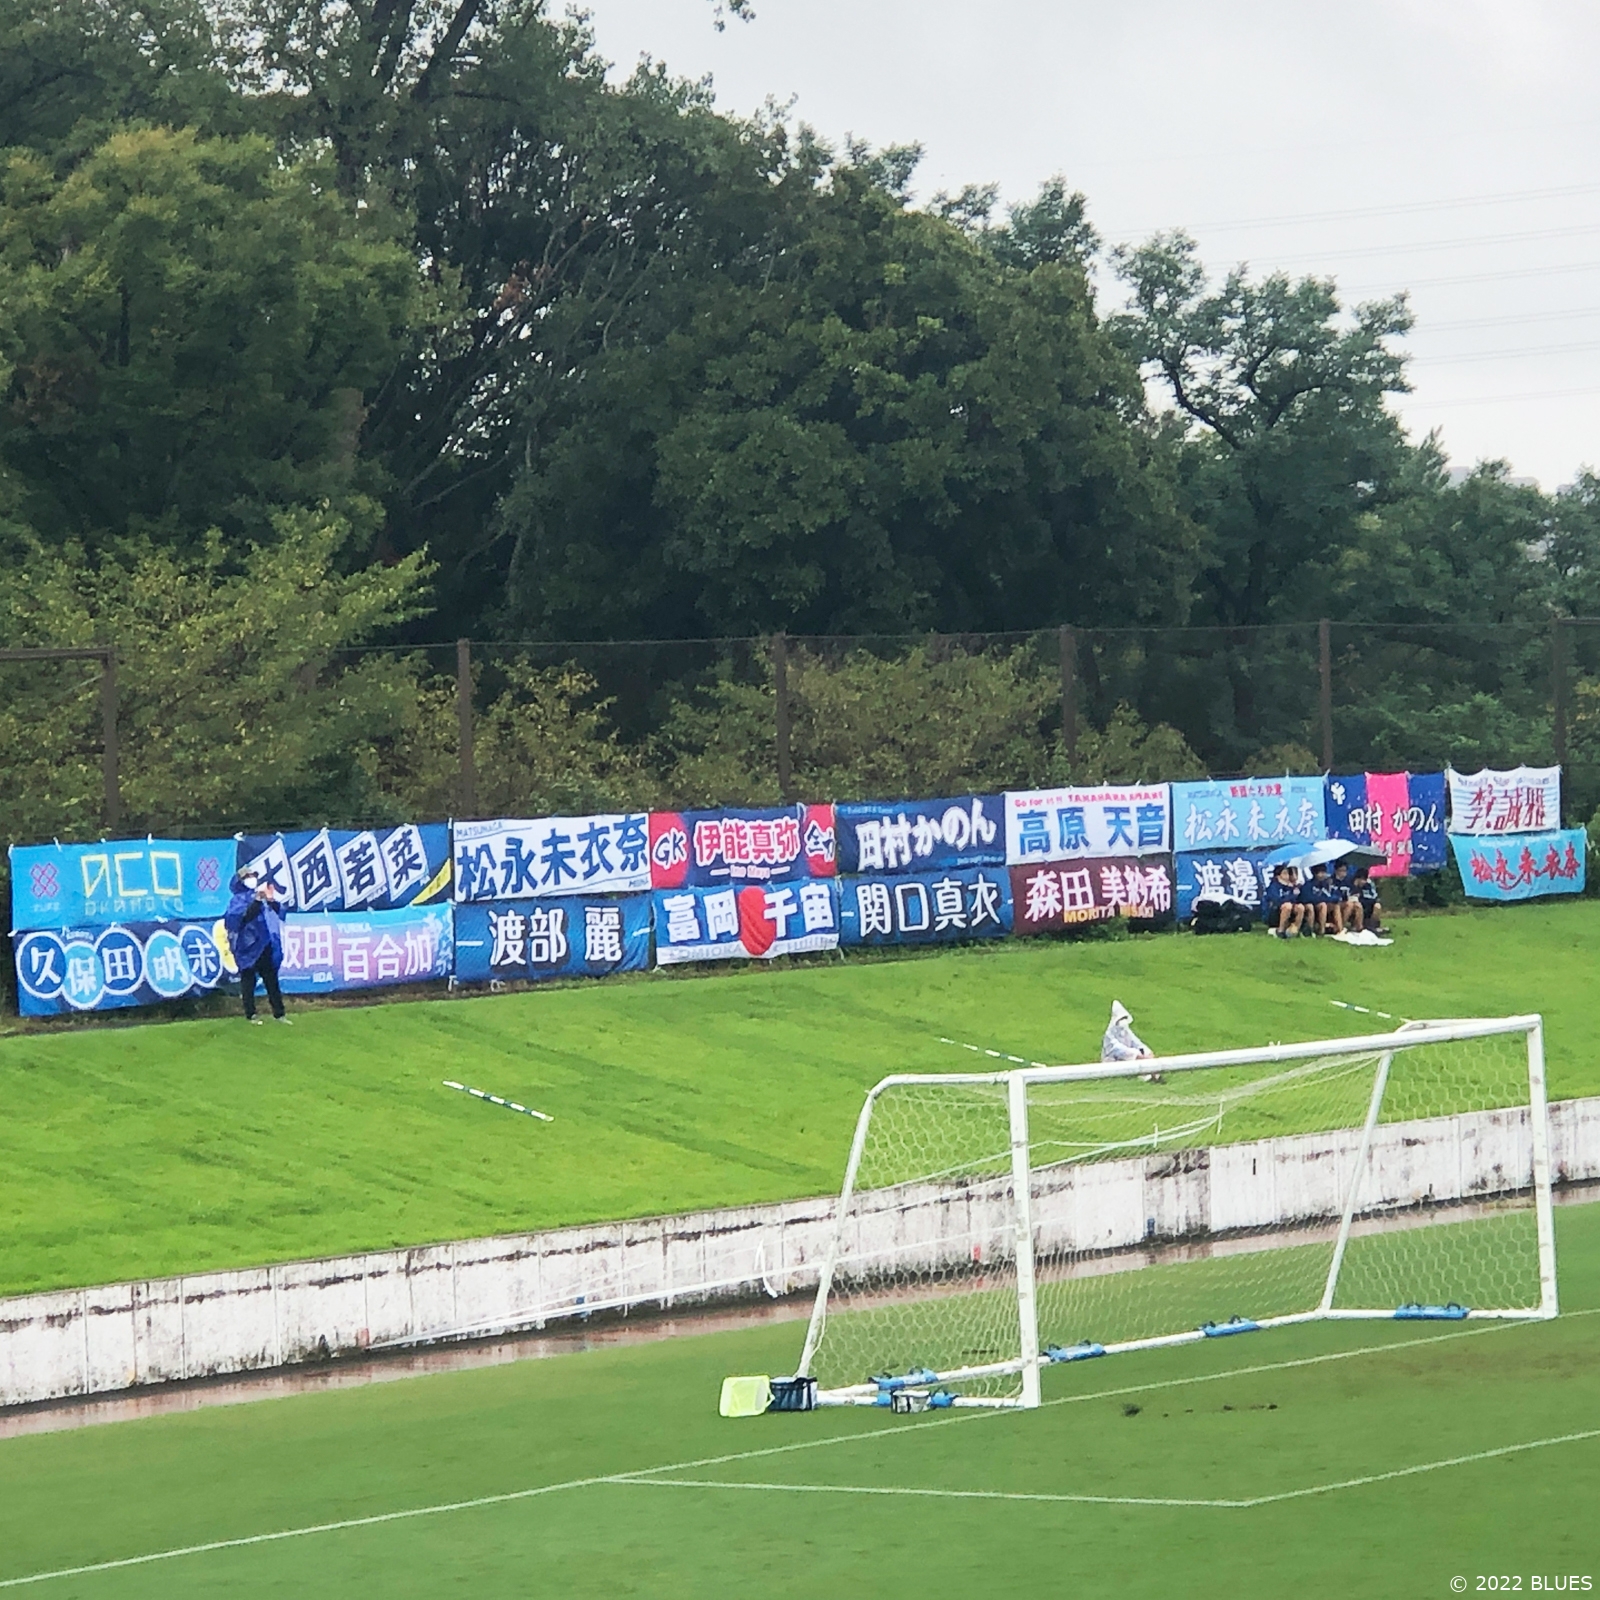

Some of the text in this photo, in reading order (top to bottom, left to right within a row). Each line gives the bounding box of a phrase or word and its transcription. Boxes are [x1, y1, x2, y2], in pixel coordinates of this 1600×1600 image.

[653, 830, 687, 868] GK
[695, 818, 799, 865] 伊能真弥
[855, 798, 997, 872] 田村かのん
[1017, 803, 1165, 855] 高原 天音
[457, 814, 648, 900] 松永未衣奈
[663, 888, 739, 943] 富岡
[857, 873, 1001, 937] 関口真衣
[1024, 867, 1095, 922] 森田
[488, 906, 623, 966] 渡部 麗
